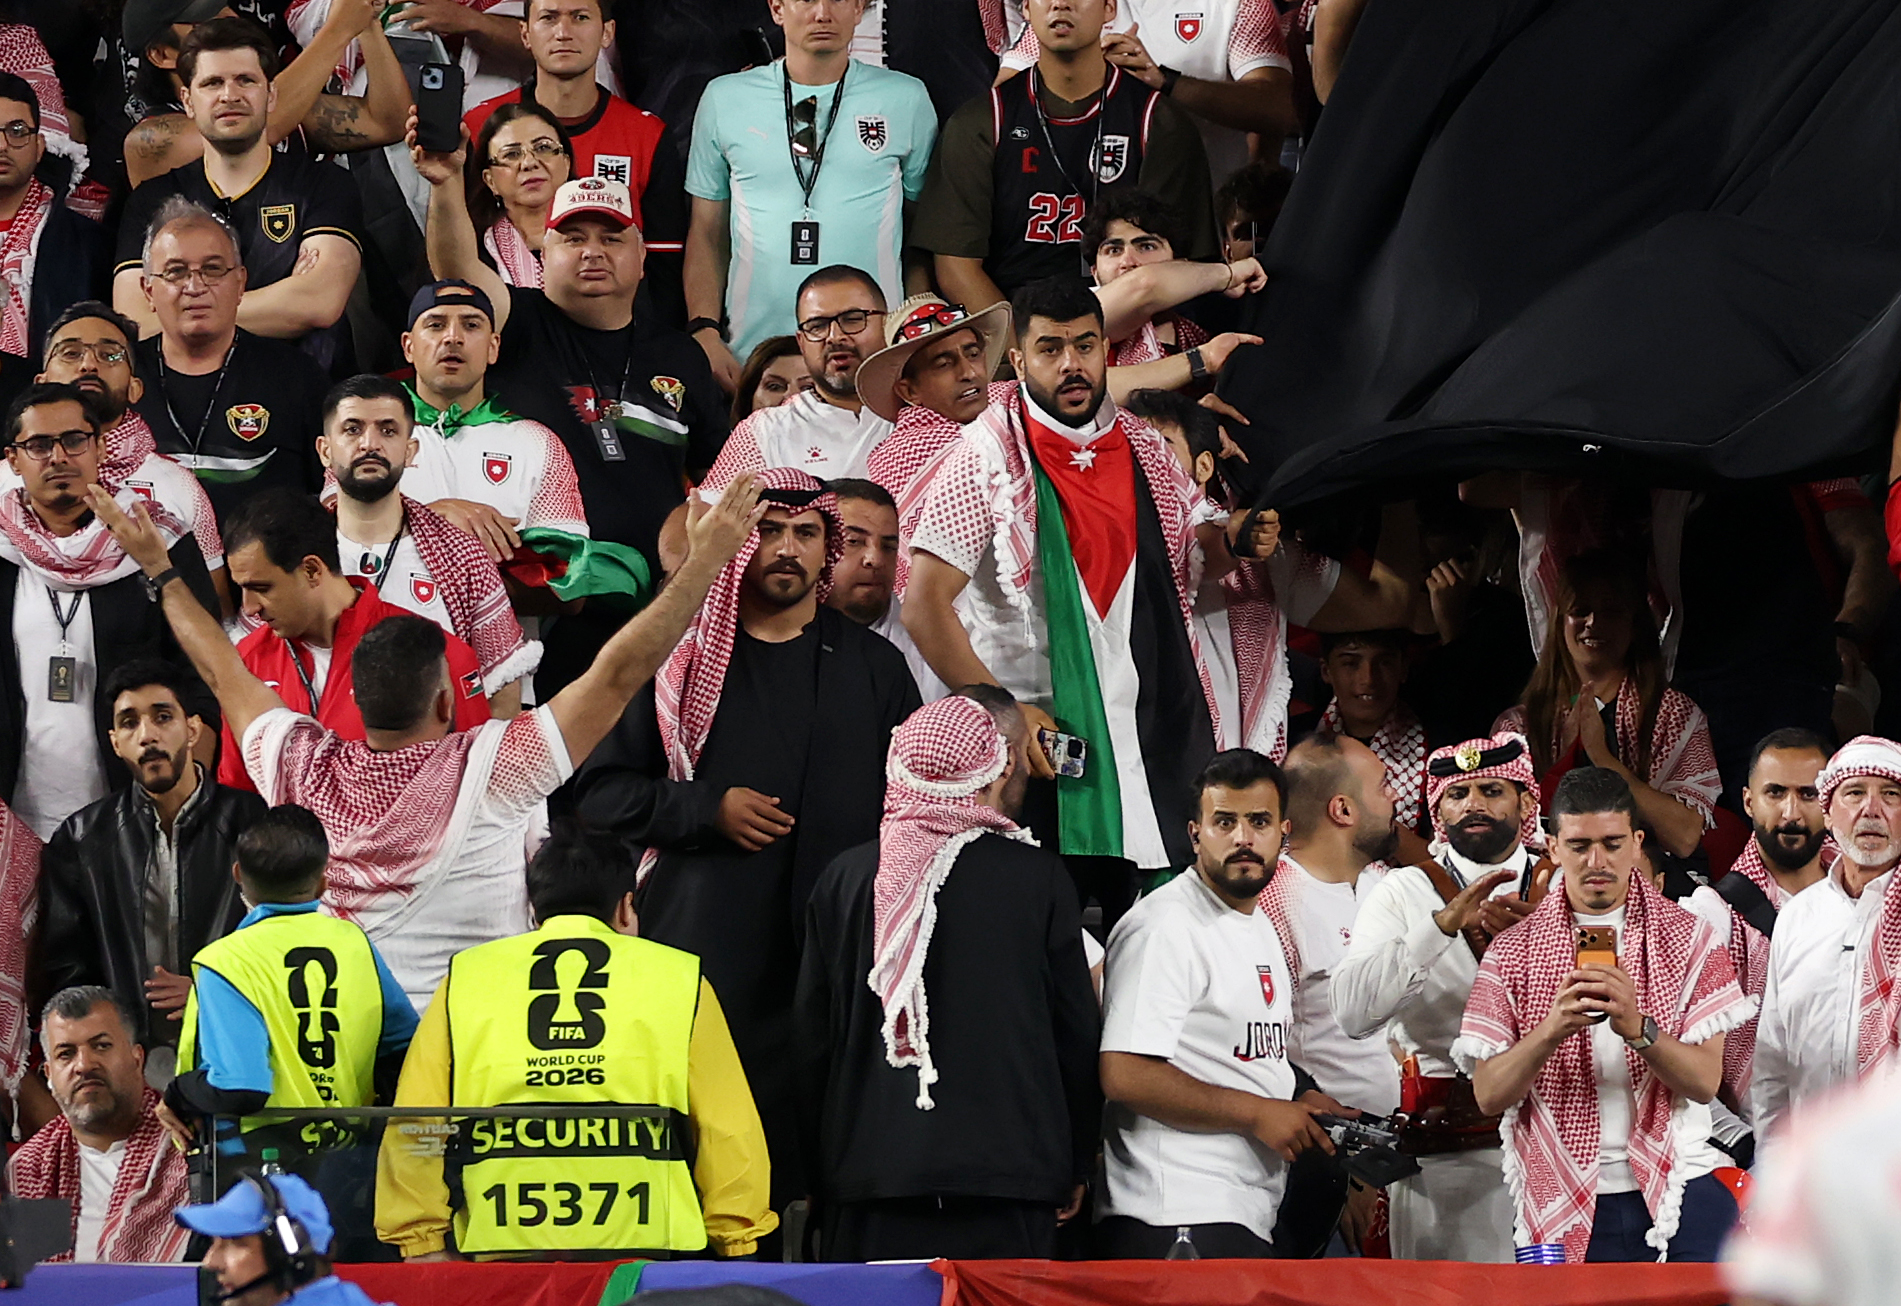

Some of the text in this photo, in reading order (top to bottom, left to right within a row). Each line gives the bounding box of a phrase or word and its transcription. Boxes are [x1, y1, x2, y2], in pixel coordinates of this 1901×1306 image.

[1025, 191, 1085, 245] 22
[548, 1026, 587, 1041] FIFA
[1234, 1022, 1289, 1062] JORD
[526, 1054, 606, 1071] WORLD CUP
[526, 1068, 607, 1087] 2026
[470, 1115, 668, 1156] SECURITY
[481, 1180, 653, 1228] 15371
